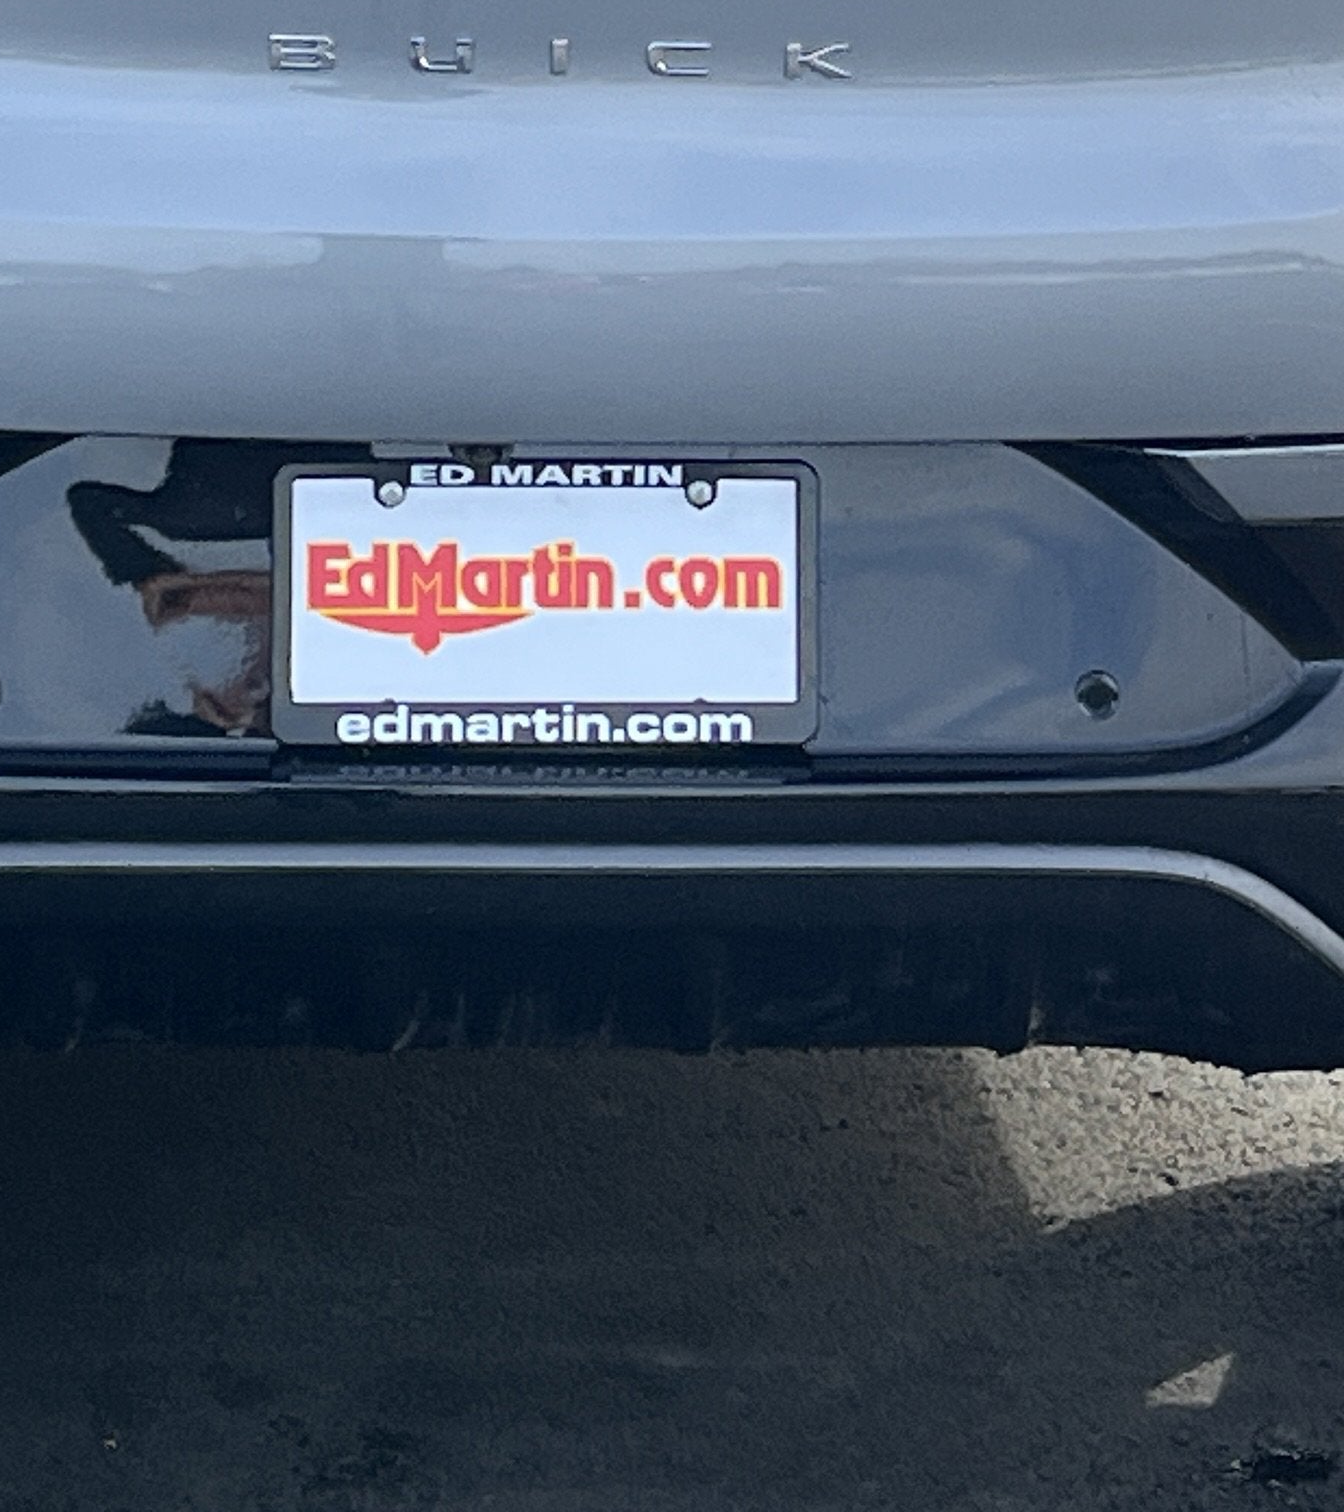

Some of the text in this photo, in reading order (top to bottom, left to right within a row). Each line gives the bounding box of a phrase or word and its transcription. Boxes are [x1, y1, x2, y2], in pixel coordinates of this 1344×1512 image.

[267, 32, 854, 80] BUICK
[409, 464, 683, 487] ED MARTIN
[306, 539, 784, 611] EdMartin.com
[336, 704, 753, 743] edmartin.com
